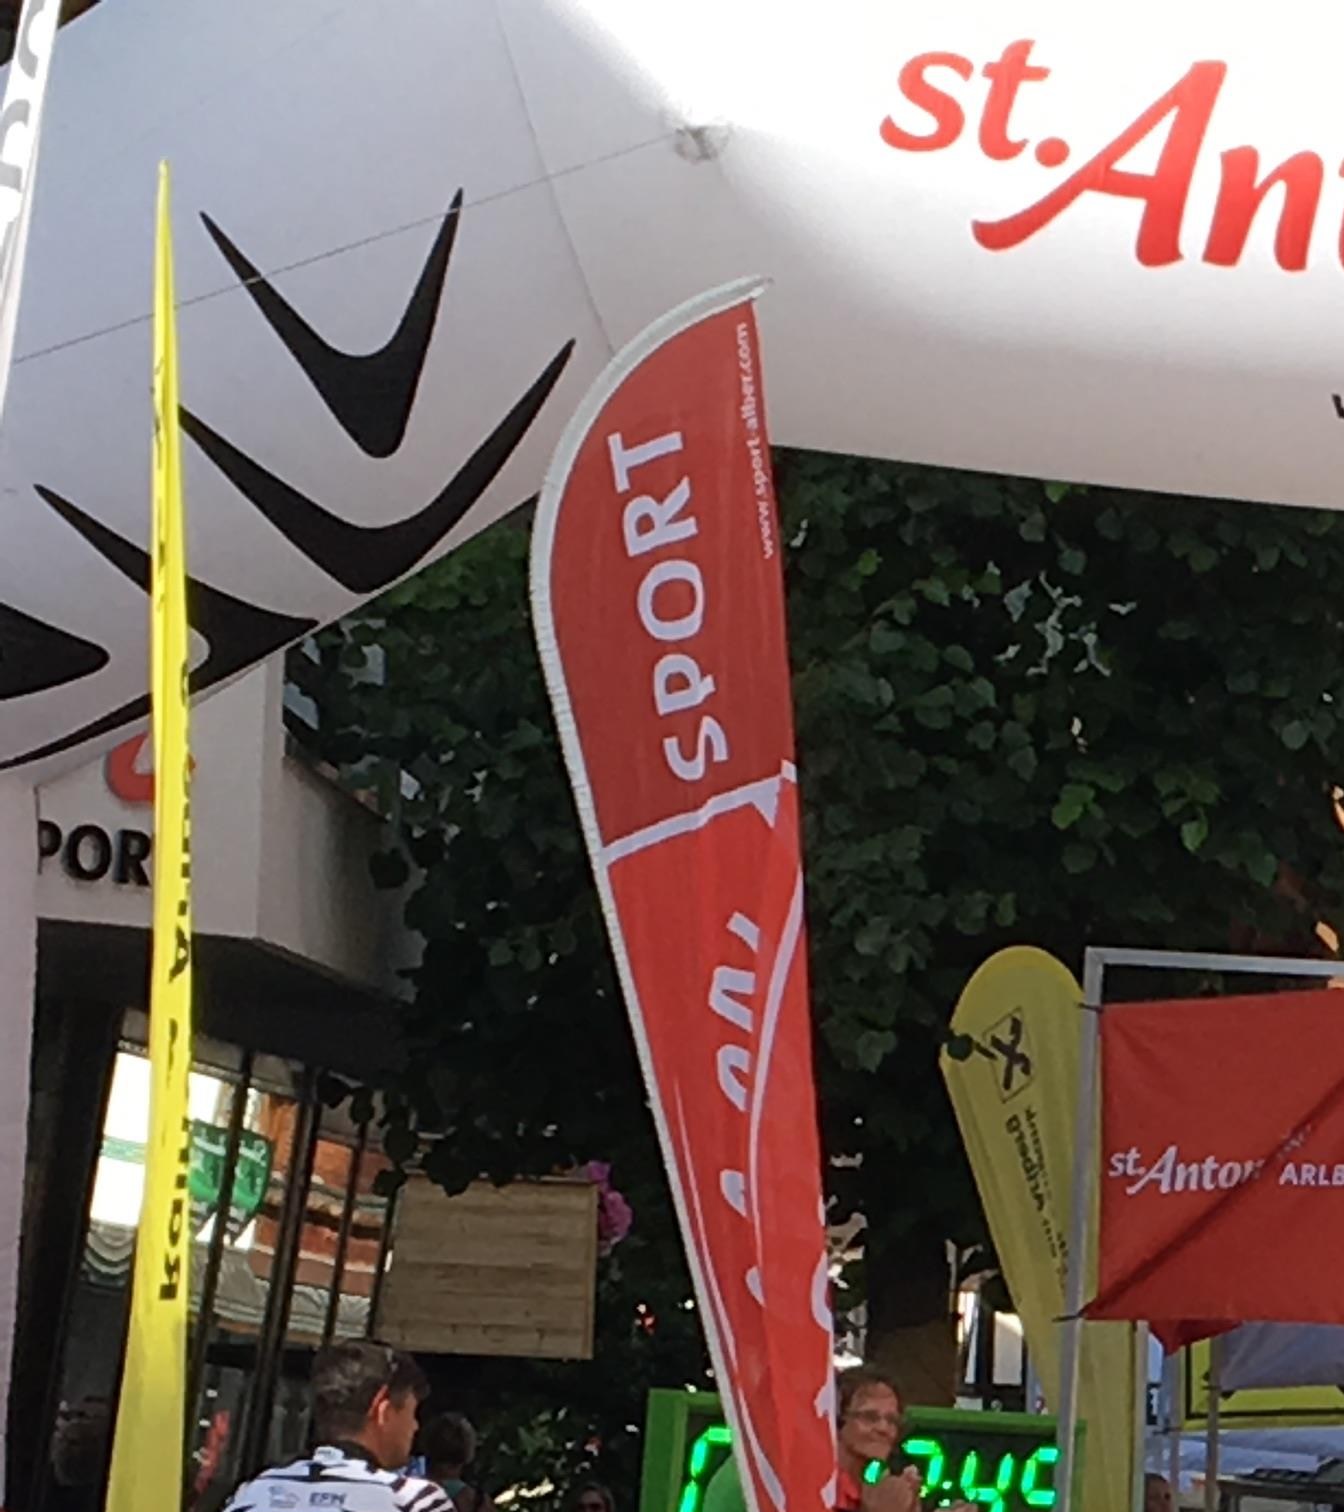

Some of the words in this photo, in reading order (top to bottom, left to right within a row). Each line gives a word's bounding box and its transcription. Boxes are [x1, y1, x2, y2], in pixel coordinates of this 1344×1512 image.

[735, 322, 773, 560] www.sport-alber.com
[607, 431, 728, 783] SPORT
[37, 819, 153, 888] POR
